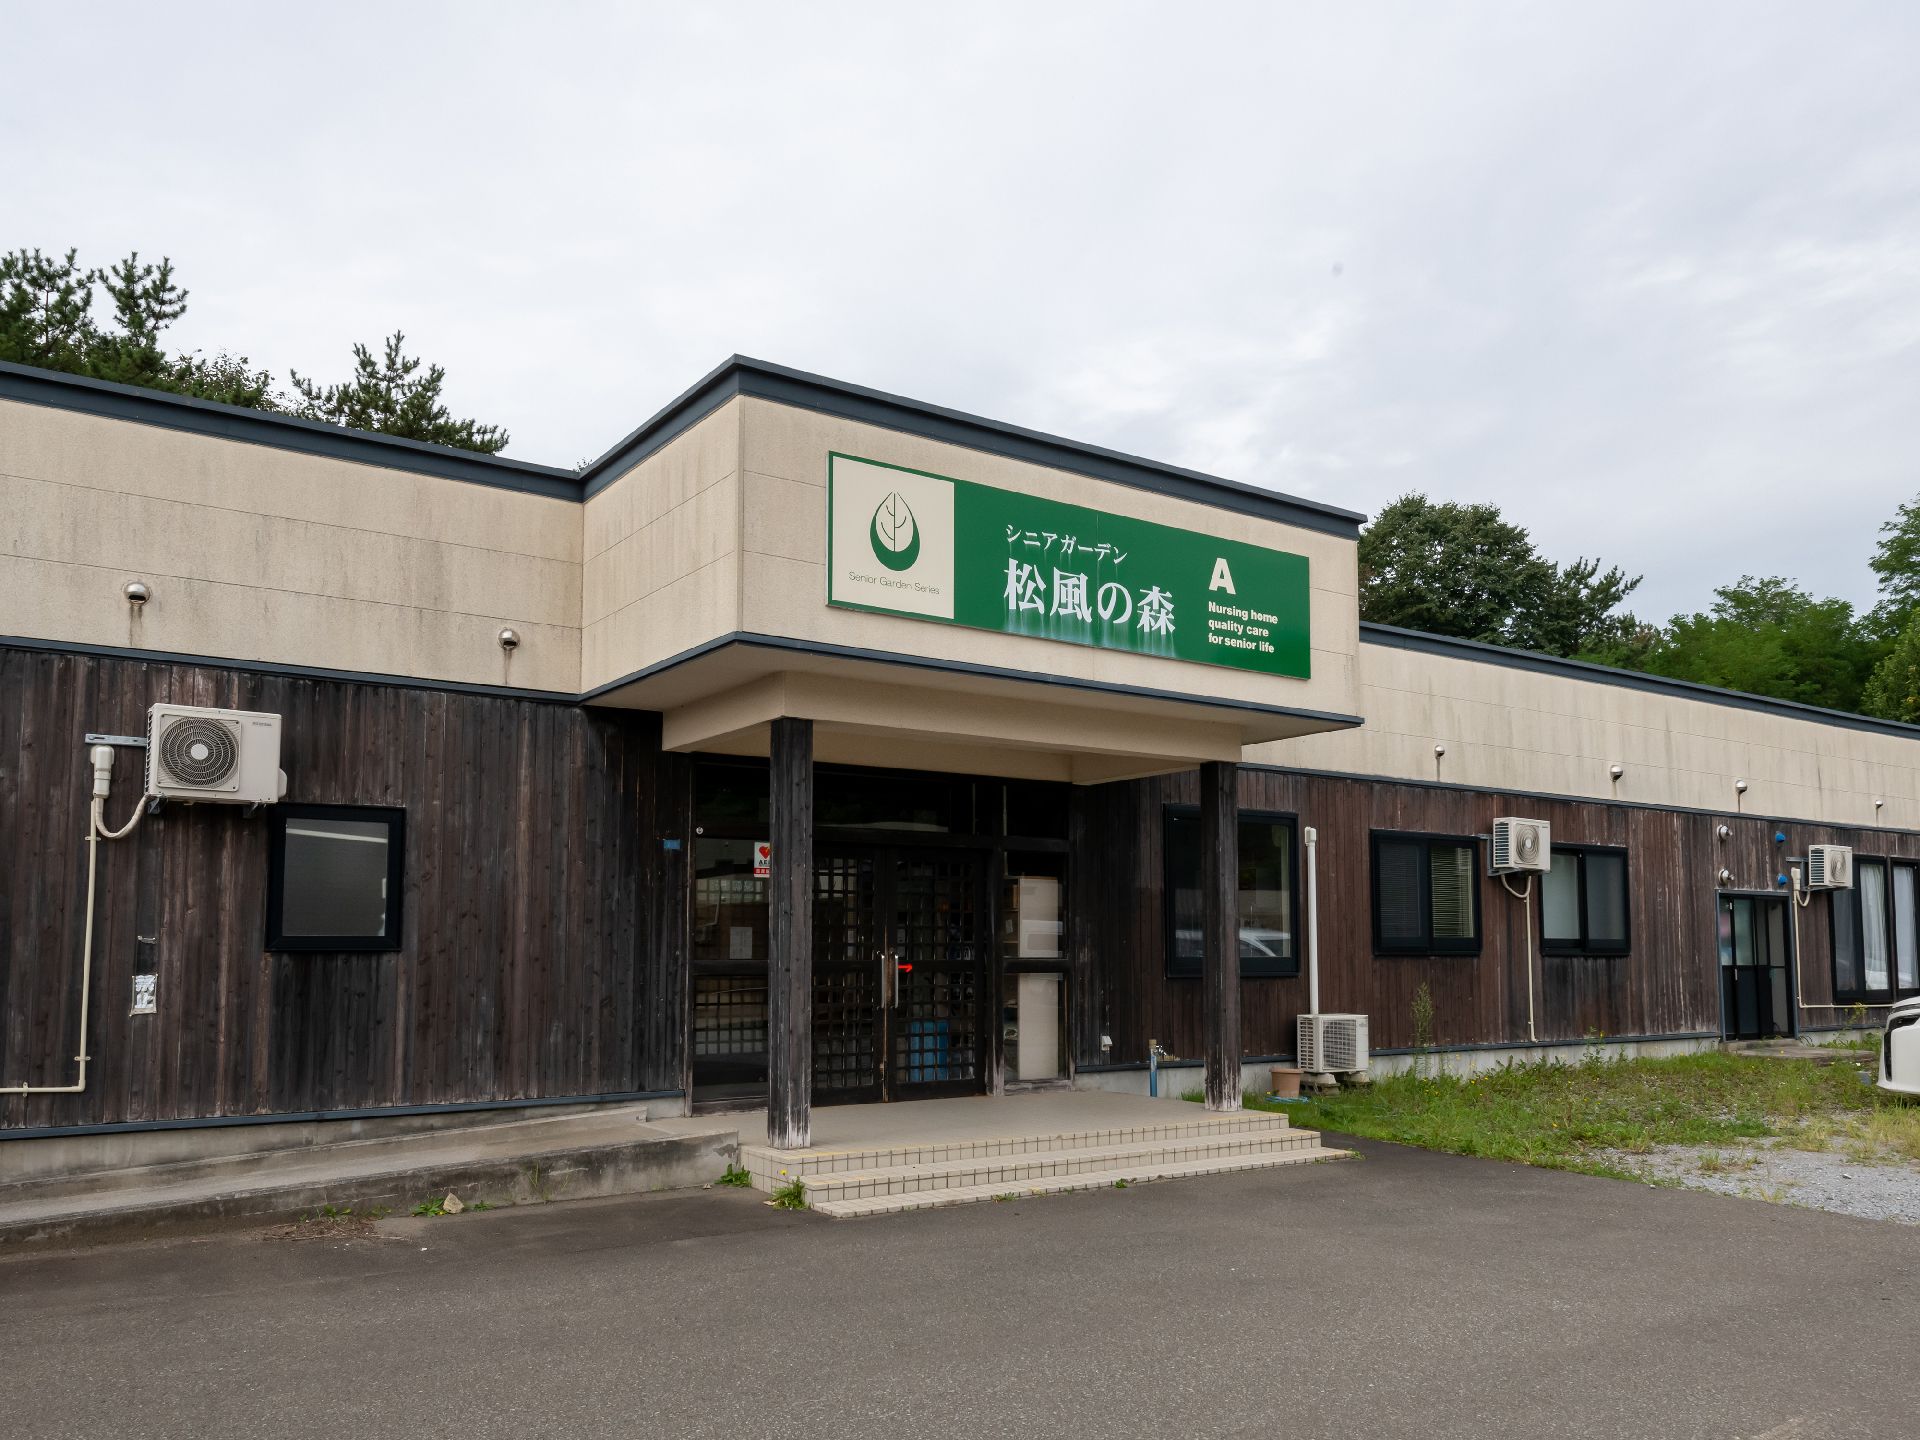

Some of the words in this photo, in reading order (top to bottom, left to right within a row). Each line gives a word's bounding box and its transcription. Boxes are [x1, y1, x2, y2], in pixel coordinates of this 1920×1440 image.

[1005, 524, 1128, 564] シニアガーデン
[848, 571, 877, 585] Senior
[879, 576, 913, 590] Garden
[914, 582, 940, 595] Series
[1208, 557, 1236, 595] A
[1003, 557, 1176, 635] 松風の森
[1208, 600, 1249, 621] Nursing
[1250, 609, 1279, 624] home
[1208, 619, 1244, 635] quality
[1246, 625, 1269, 637] care
[1208, 632, 1224, 645] for
[1224, 638, 1257, 650] senior
[1259, 640, 1275, 653] life
